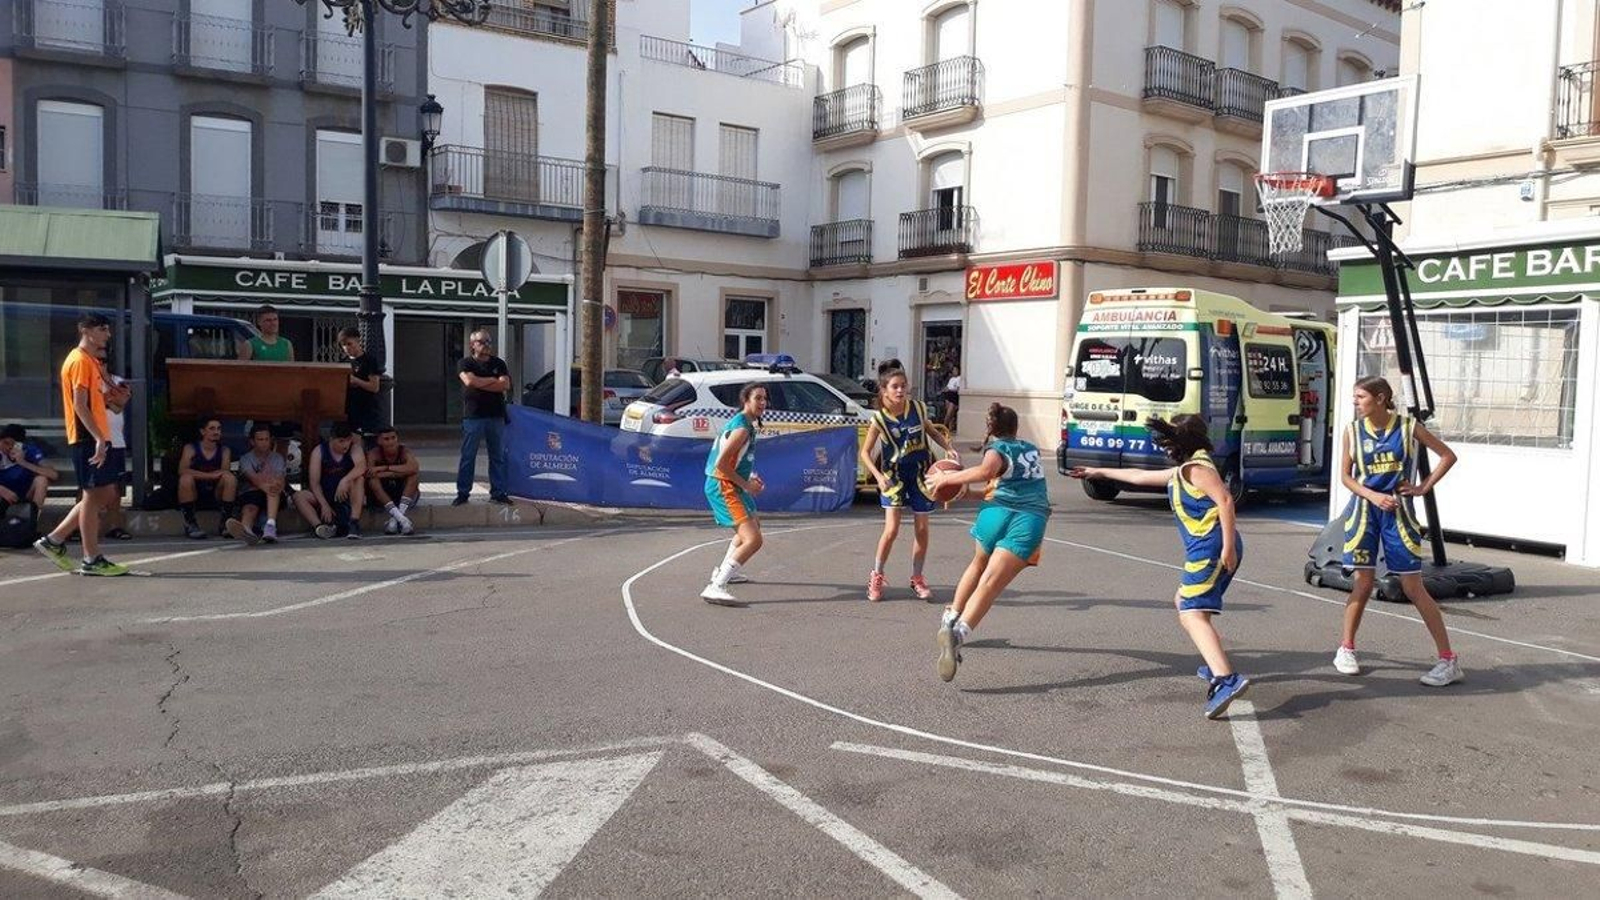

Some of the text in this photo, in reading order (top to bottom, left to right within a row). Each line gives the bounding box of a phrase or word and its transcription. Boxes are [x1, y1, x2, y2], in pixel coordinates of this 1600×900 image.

[1418, 252, 1516, 284] CAFE
[235, 271, 307, 289] CAFE
[328, 275, 364, 291] BA
[402, 278, 433, 295] LA
[967, 265, 1053, 298] El Corte Chino
[1092, 310, 1177, 322] AMBULANCIA
[1141, 323, 1184, 331] AVANZADO
[1144, 354, 1177, 364] vithas
[1263, 356, 1277, 372] 24
[1080, 437, 1103, 447] 696
[1107, 438, 1124, 449] 99
[1128, 439, 1146, 450] 77
[529, 453, 580, 463] DIPUTACIÓN
